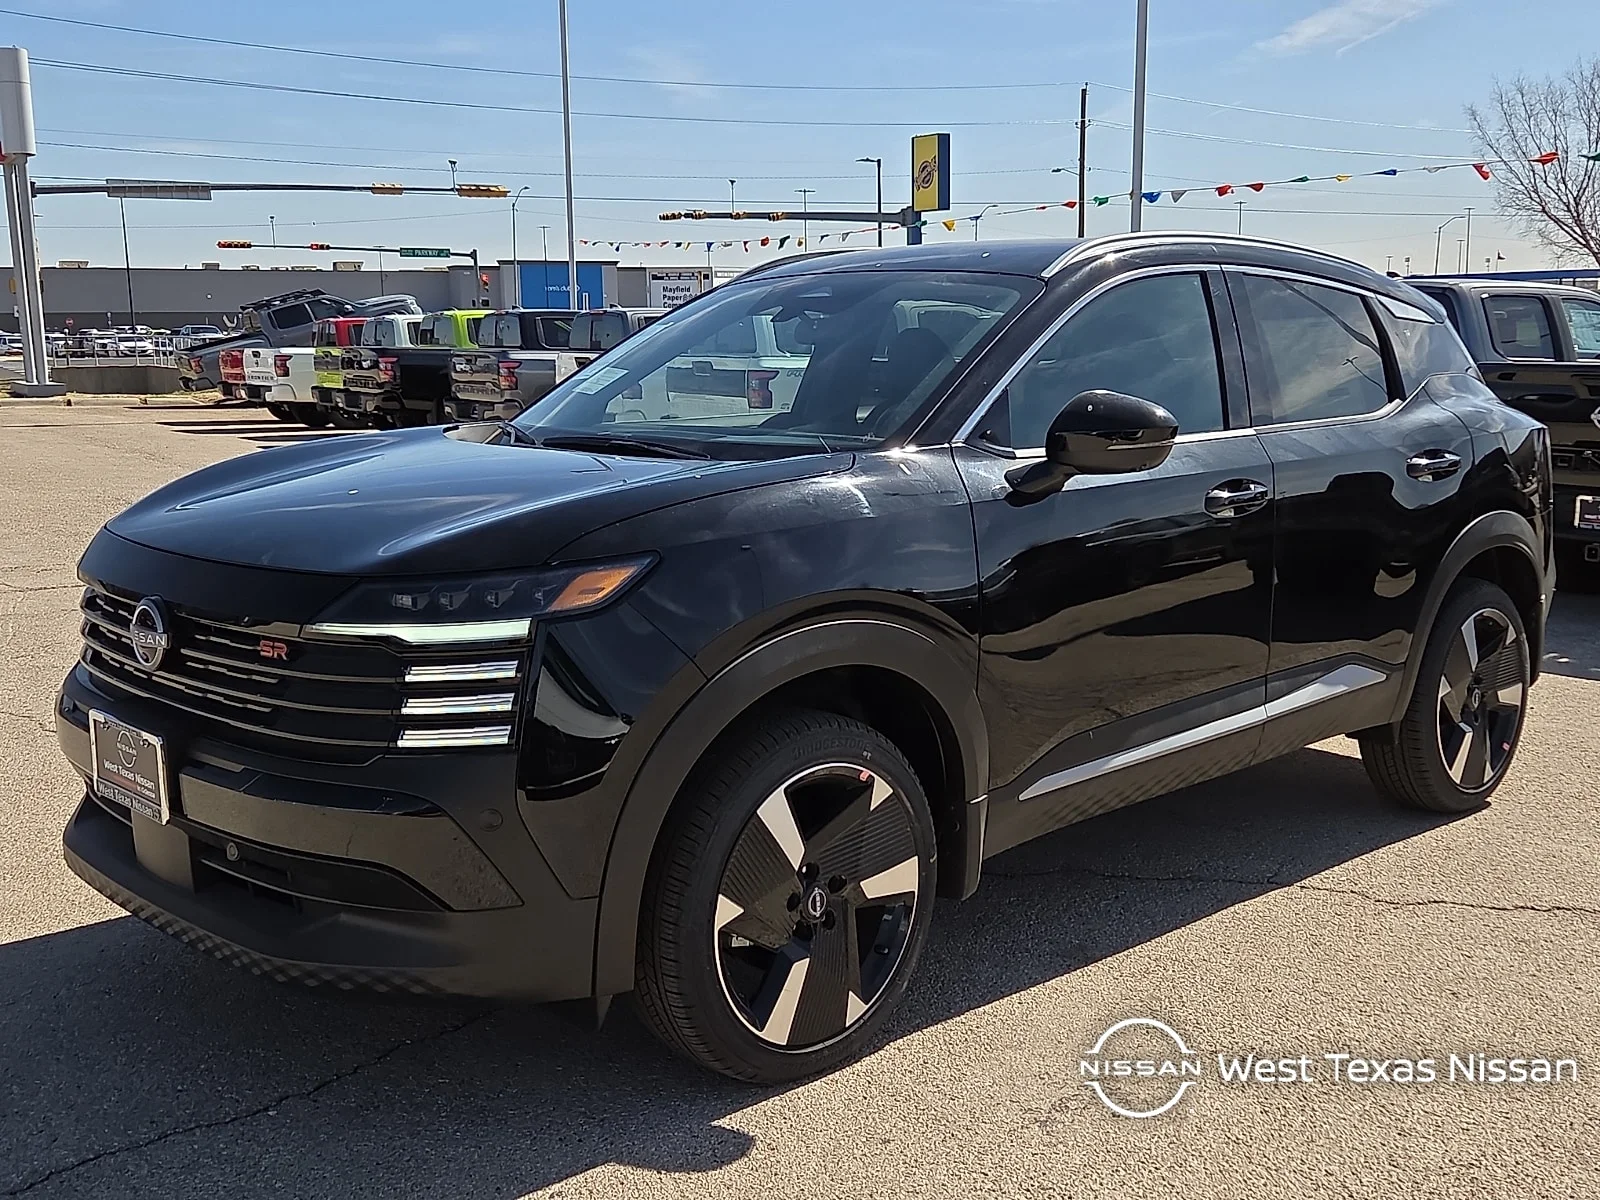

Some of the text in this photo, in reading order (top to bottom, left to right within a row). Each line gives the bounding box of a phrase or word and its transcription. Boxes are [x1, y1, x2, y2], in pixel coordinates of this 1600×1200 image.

[414, 249, 439, 257] PARKWAY
[662, 285, 691, 295] Mayfield
[662, 294, 682, 302] Paper
[134, 630, 165, 646] SSAN
[259, 639, 288, 661] SR
[103, 759, 155, 790] West Texas Nissan
[98, 782, 114, 800] West
[114, 790, 132, 806] Texas
[132, 798, 153, 818] Nissan
